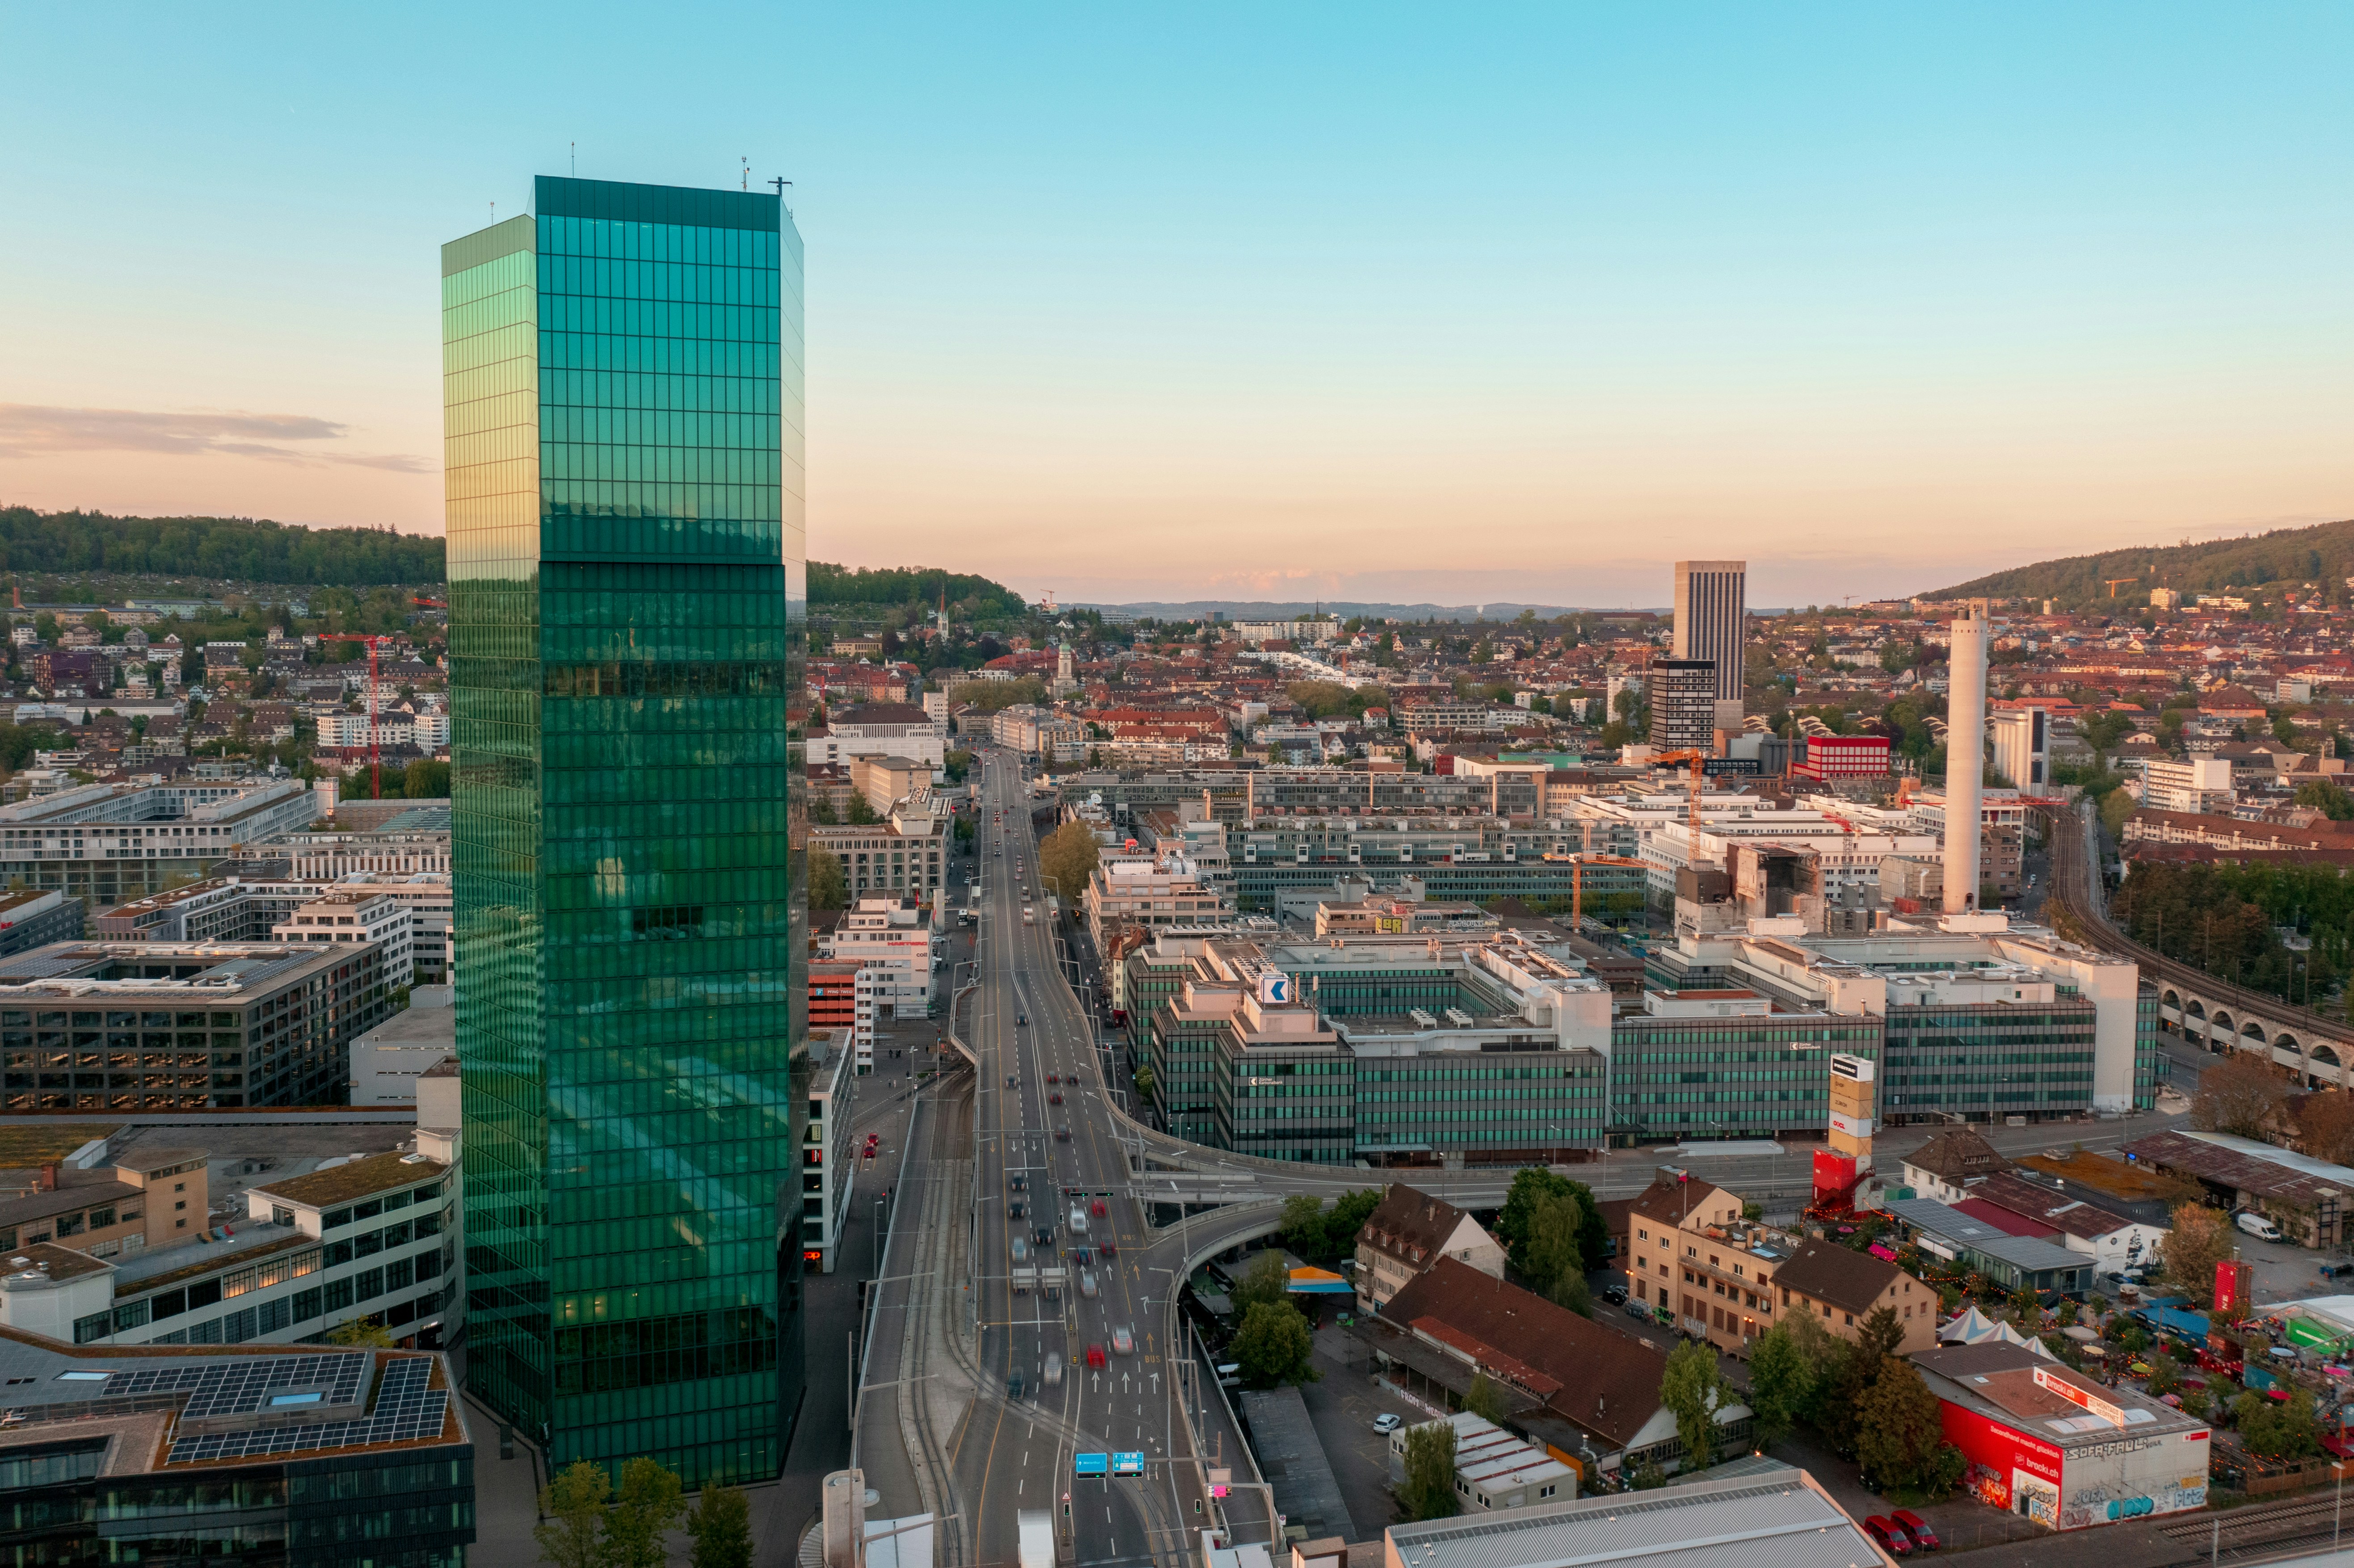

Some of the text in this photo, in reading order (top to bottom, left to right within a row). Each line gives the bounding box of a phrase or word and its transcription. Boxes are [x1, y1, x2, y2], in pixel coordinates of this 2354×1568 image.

[1145, 1355, 1161, 1363] BUS
[2047, 1377, 2075, 1399] brocki.ch
[2096, 1401, 2119, 1415] MONTAGS
[2096, 1408, 2119, 1423] GEÖFFNET
[1990, 1425, 2019, 1442] Secondhand
[2020, 1438, 2036, 1450] macht
[2036, 1445, 2059, 1459] glücklich
[2026, 1457, 2059, 1479] brocki.ch
